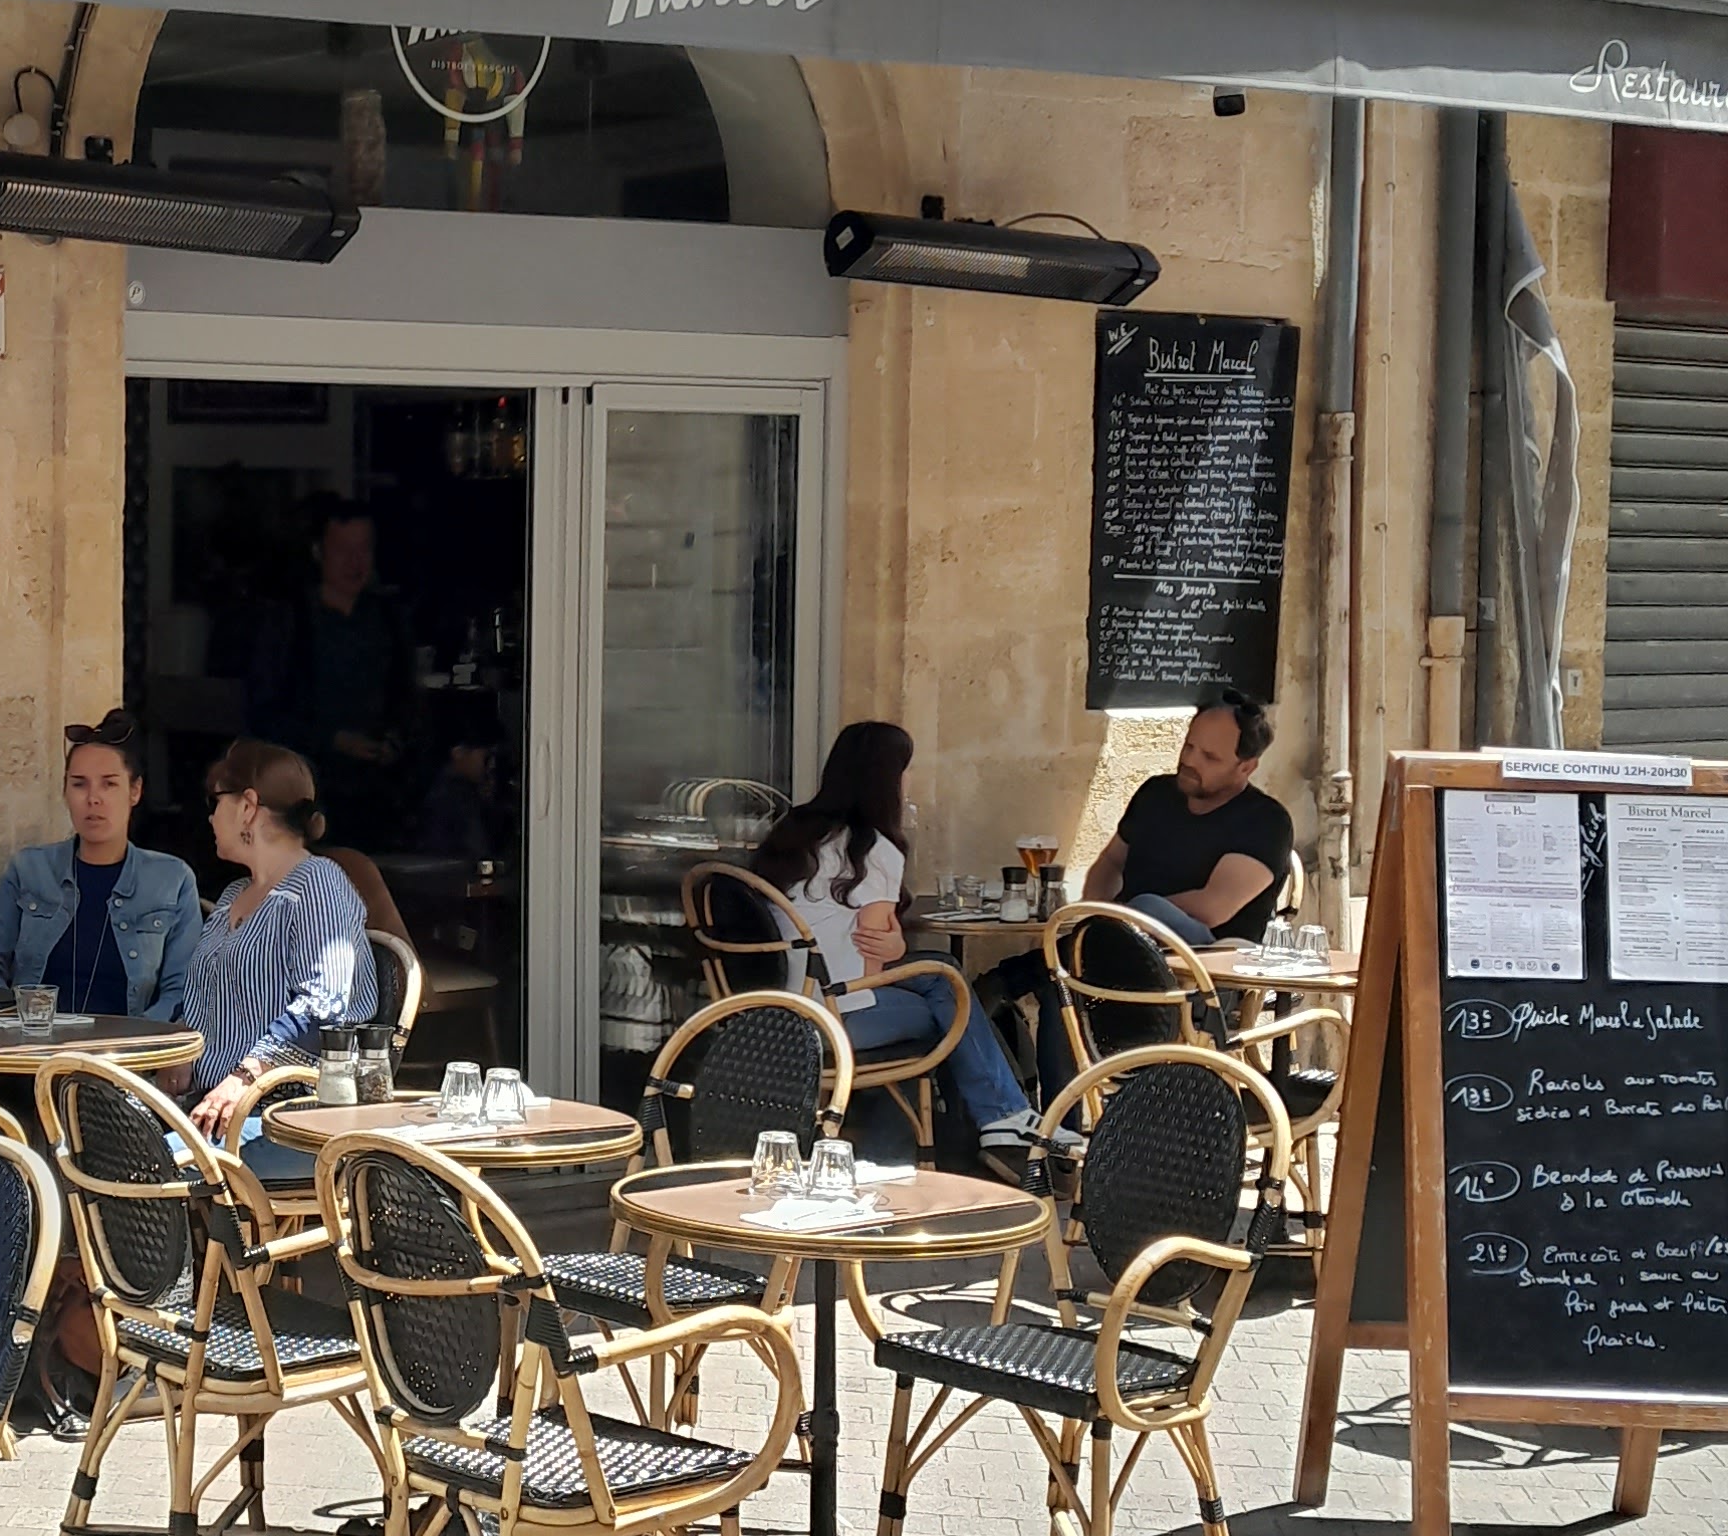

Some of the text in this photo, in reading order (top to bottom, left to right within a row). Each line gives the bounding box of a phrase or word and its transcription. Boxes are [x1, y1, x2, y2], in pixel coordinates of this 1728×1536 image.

[1570, 39, 1728, 109] Restaur
[1146, 336, 1260, 375] Bistrot Marcel
[1505, 762, 1688, 779] SERVICE CONTINU 12H-20H30
[1627, 805, 1712, 819] Bistrot Marcel
[1511, 1001, 1571, 1044] Quiche
[1605, 1097, 1663, 1117] Burrata
